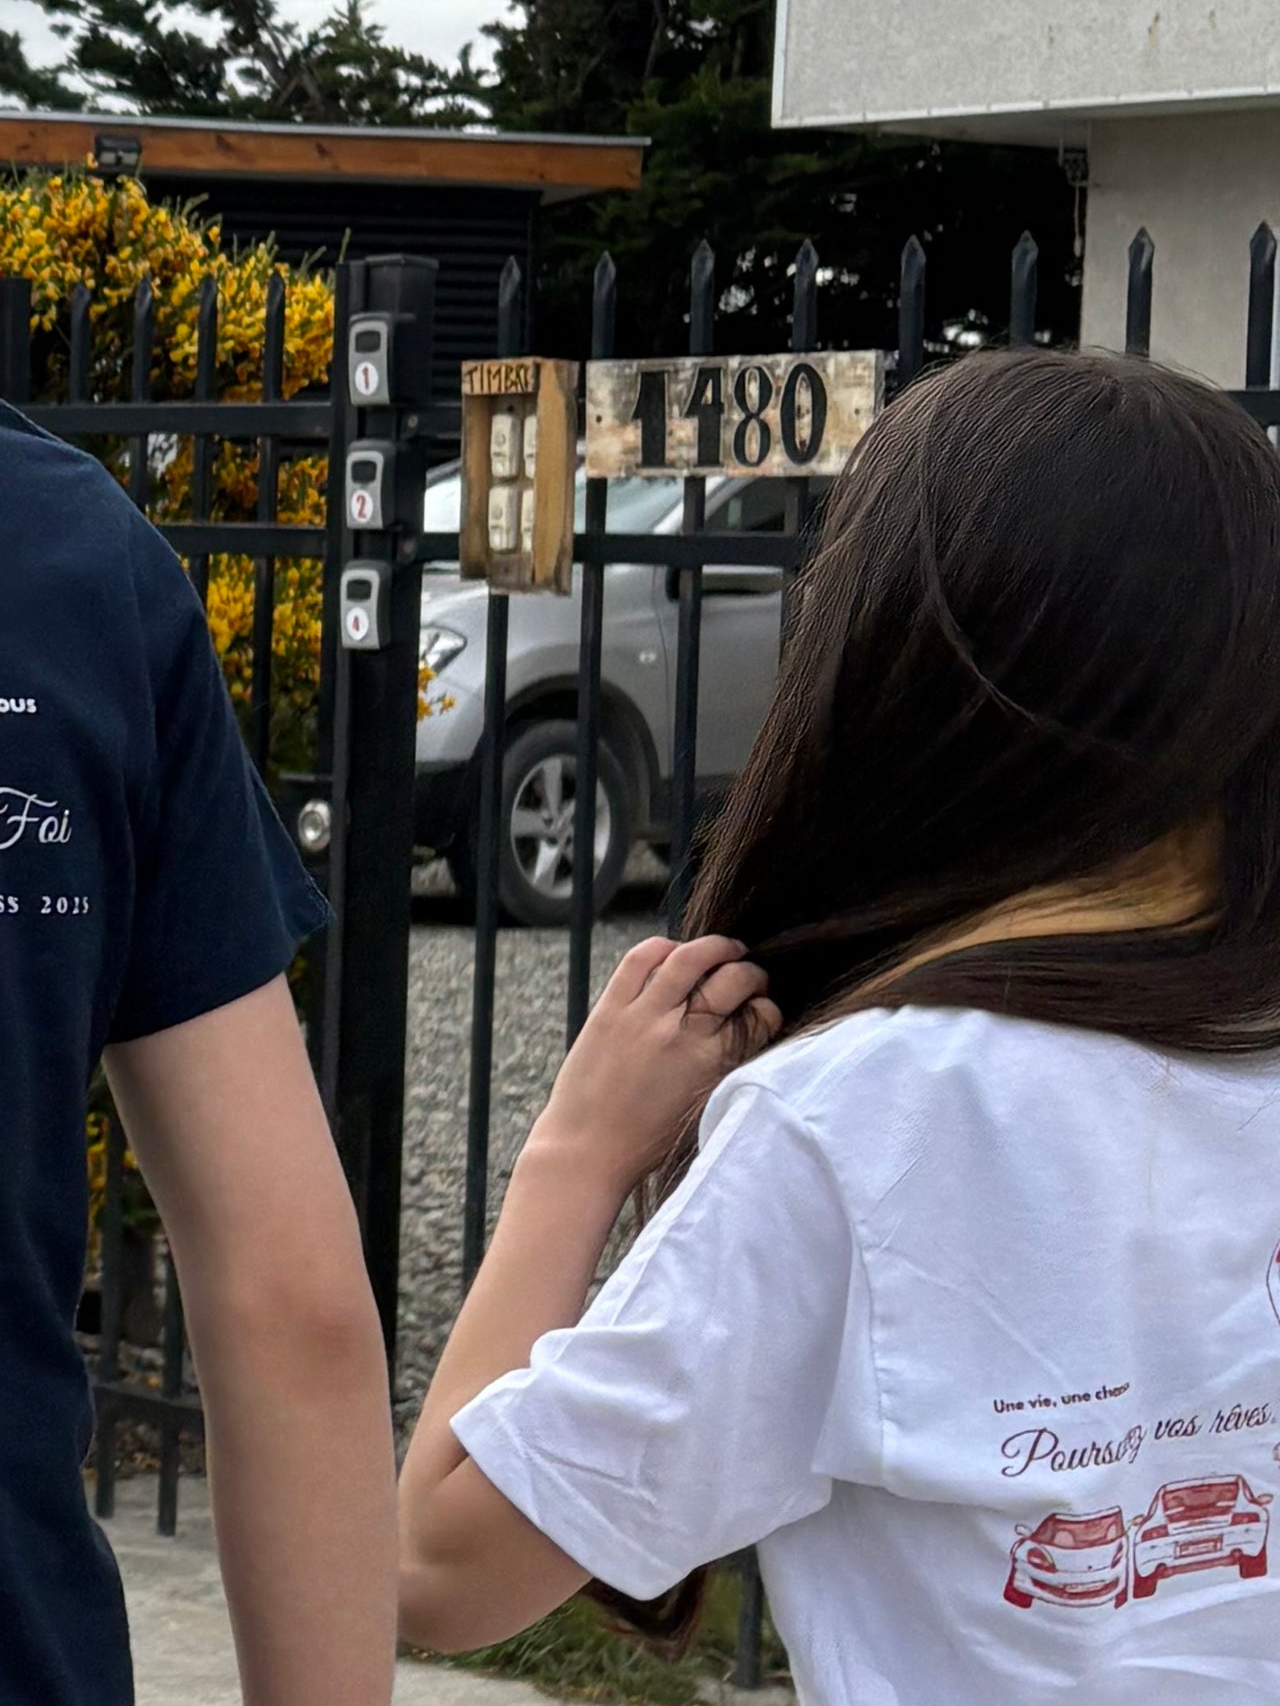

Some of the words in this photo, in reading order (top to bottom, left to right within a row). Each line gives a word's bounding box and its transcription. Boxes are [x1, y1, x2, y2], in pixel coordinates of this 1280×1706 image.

[362, 365, 370, 390] 1
[631, 363, 827, 467] 1480
[356, 494, 367, 519] 2
[993, 1399, 1025, 1414] Une
[1028, 1394, 1057, 1408] vie,
[1061, 1392, 1092, 1405] une
[1154, 1415, 1202, 1440] vos
